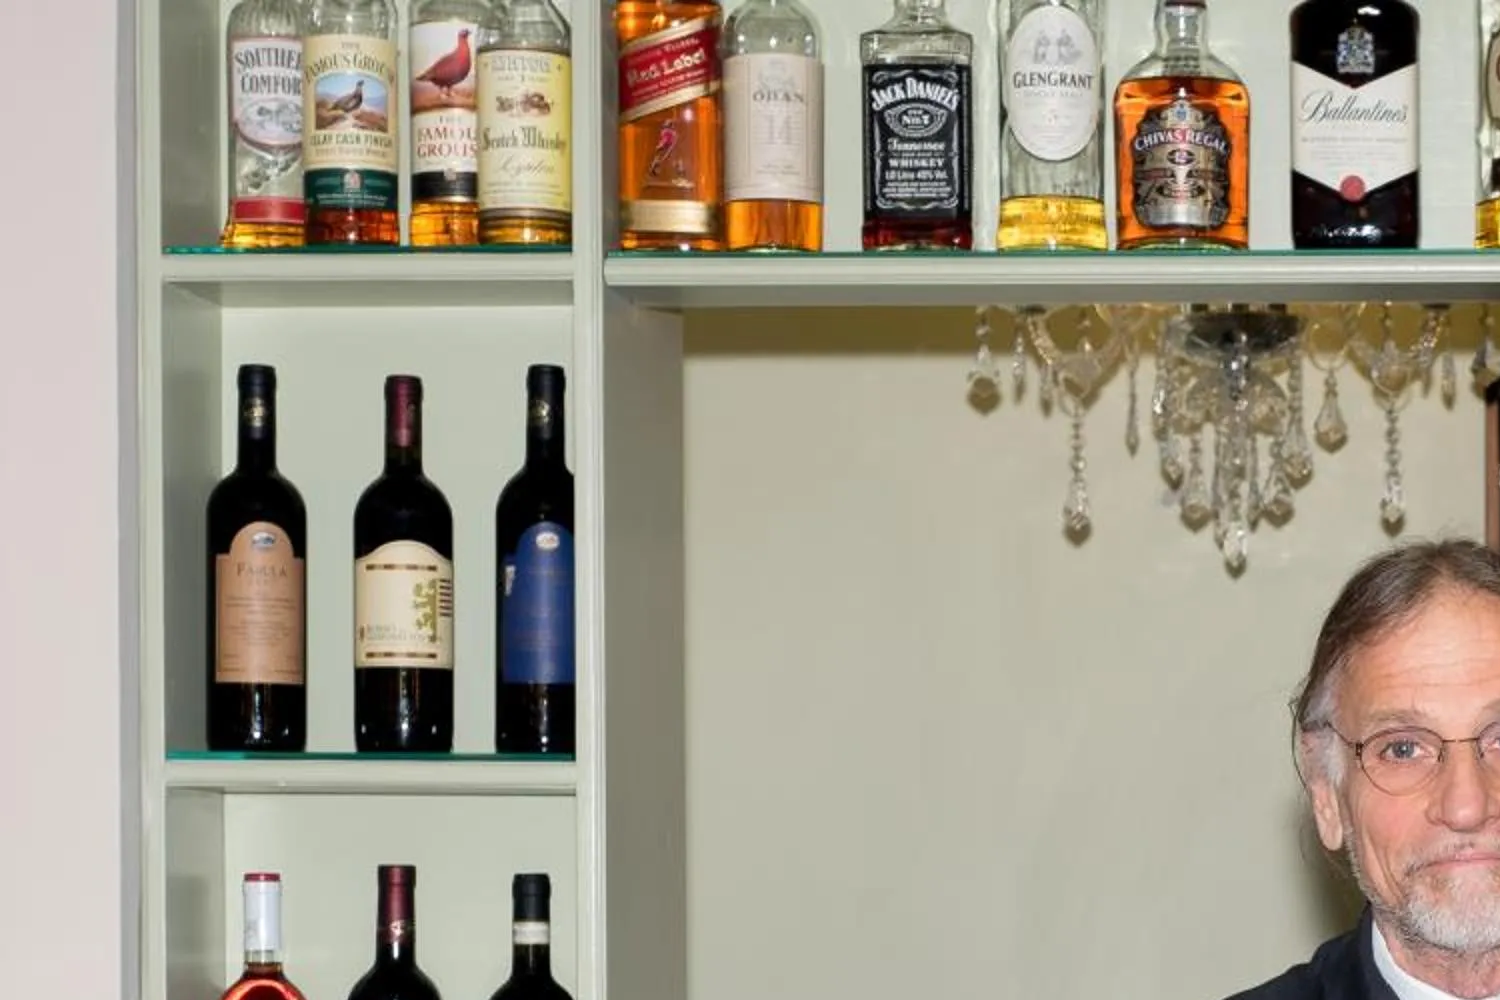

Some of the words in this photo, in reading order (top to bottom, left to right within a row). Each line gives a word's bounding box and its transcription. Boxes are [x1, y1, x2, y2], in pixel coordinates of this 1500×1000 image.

[235, 47, 302, 71] SOUTHE
[241, 73, 302, 94] COMFOR
[871, 83, 905, 111] JACK
[905, 77, 959, 112] DANIEL'S
[1301, 89, 1408, 125] Ballantine's
[417, 127, 477, 142] FAMOU
[1135, 128, 1185, 151] CHIVAS
[1186, 128, 1229, 154] REGAL
[417, 143, 477, 158] GROUS
